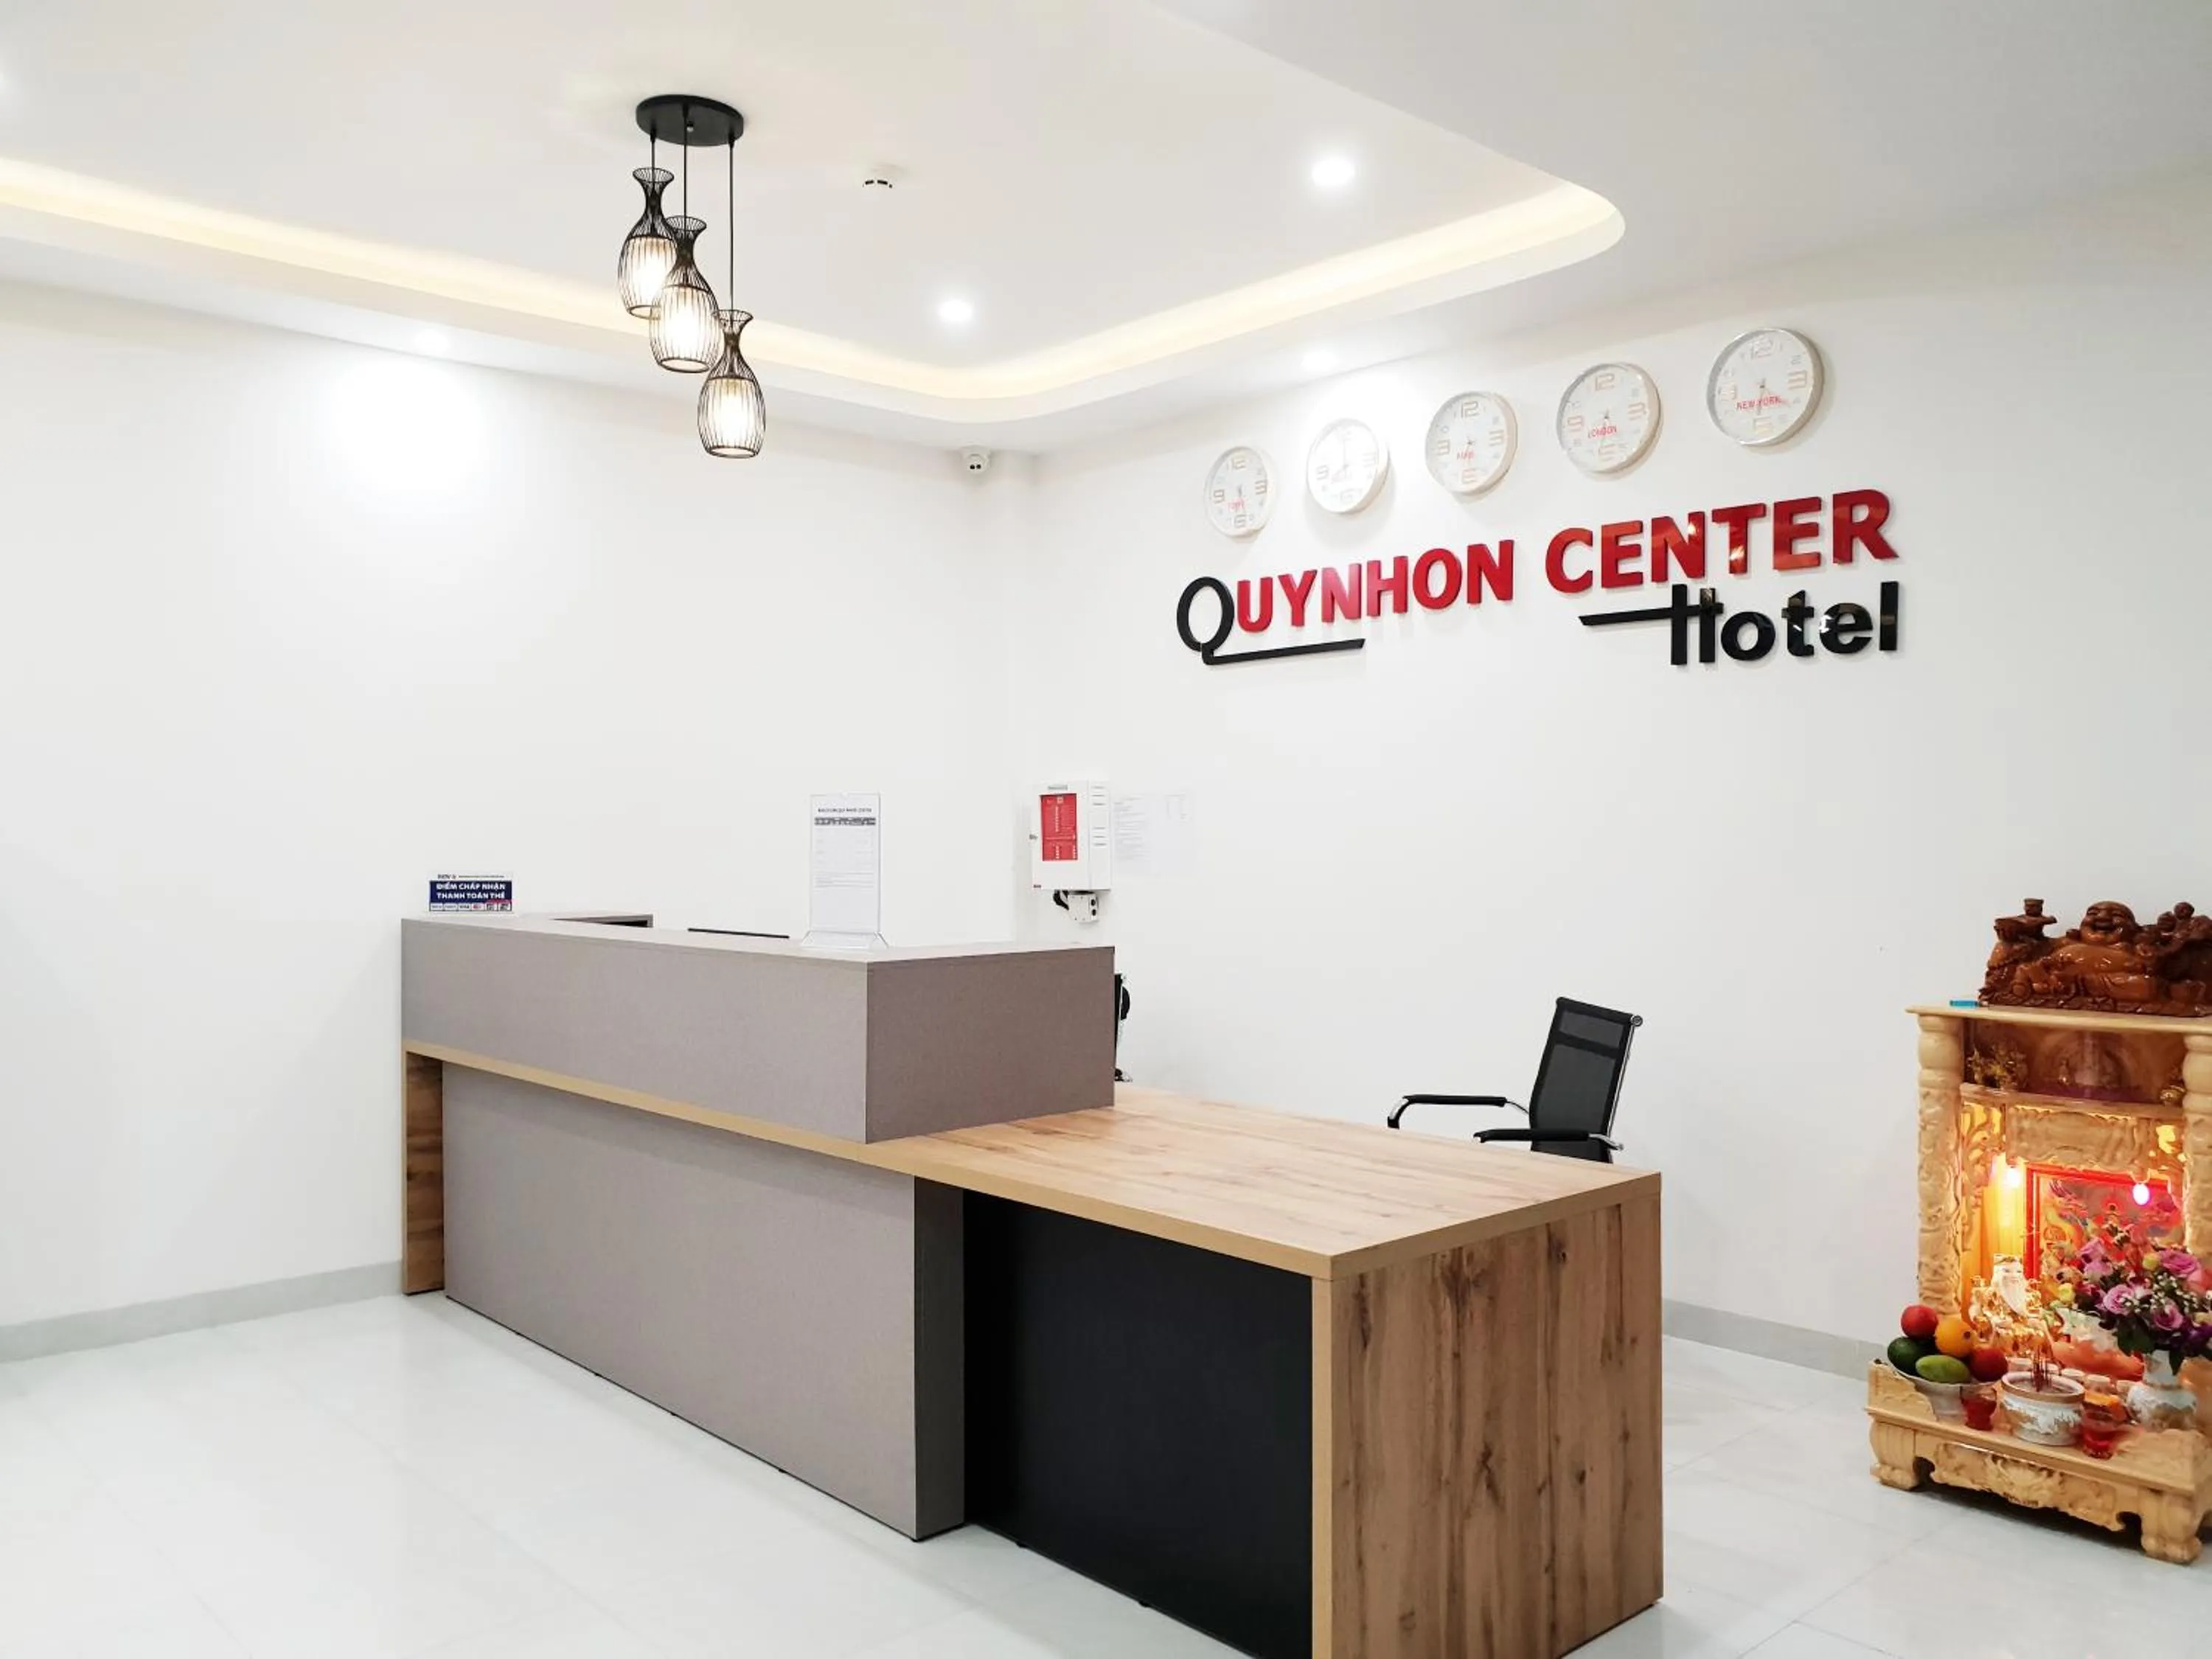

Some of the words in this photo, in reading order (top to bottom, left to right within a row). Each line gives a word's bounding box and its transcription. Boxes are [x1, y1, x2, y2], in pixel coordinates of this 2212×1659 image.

[1176, 539, 1514, 665] QUYNHON
[1545, 489, 1900, 594] CENTER
[1578, 580, 1900, 665] Hotel
